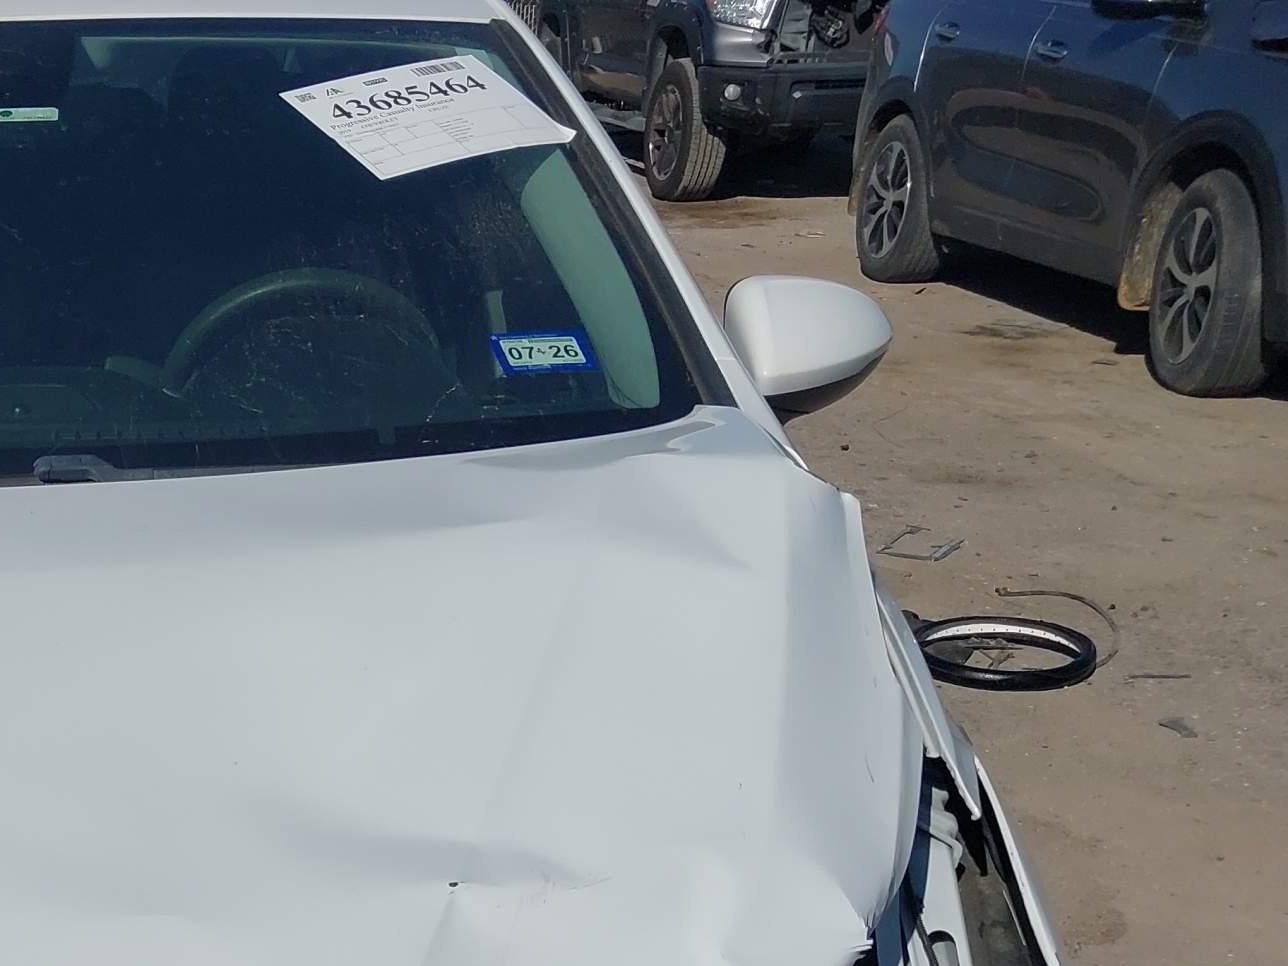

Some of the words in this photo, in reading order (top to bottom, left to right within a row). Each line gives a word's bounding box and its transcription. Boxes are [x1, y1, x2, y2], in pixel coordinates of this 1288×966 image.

[332, 75, 487, 119] 43685464
[330, 114, 379, 130] Progressive
[379, 104, 415, 119] Casualty
